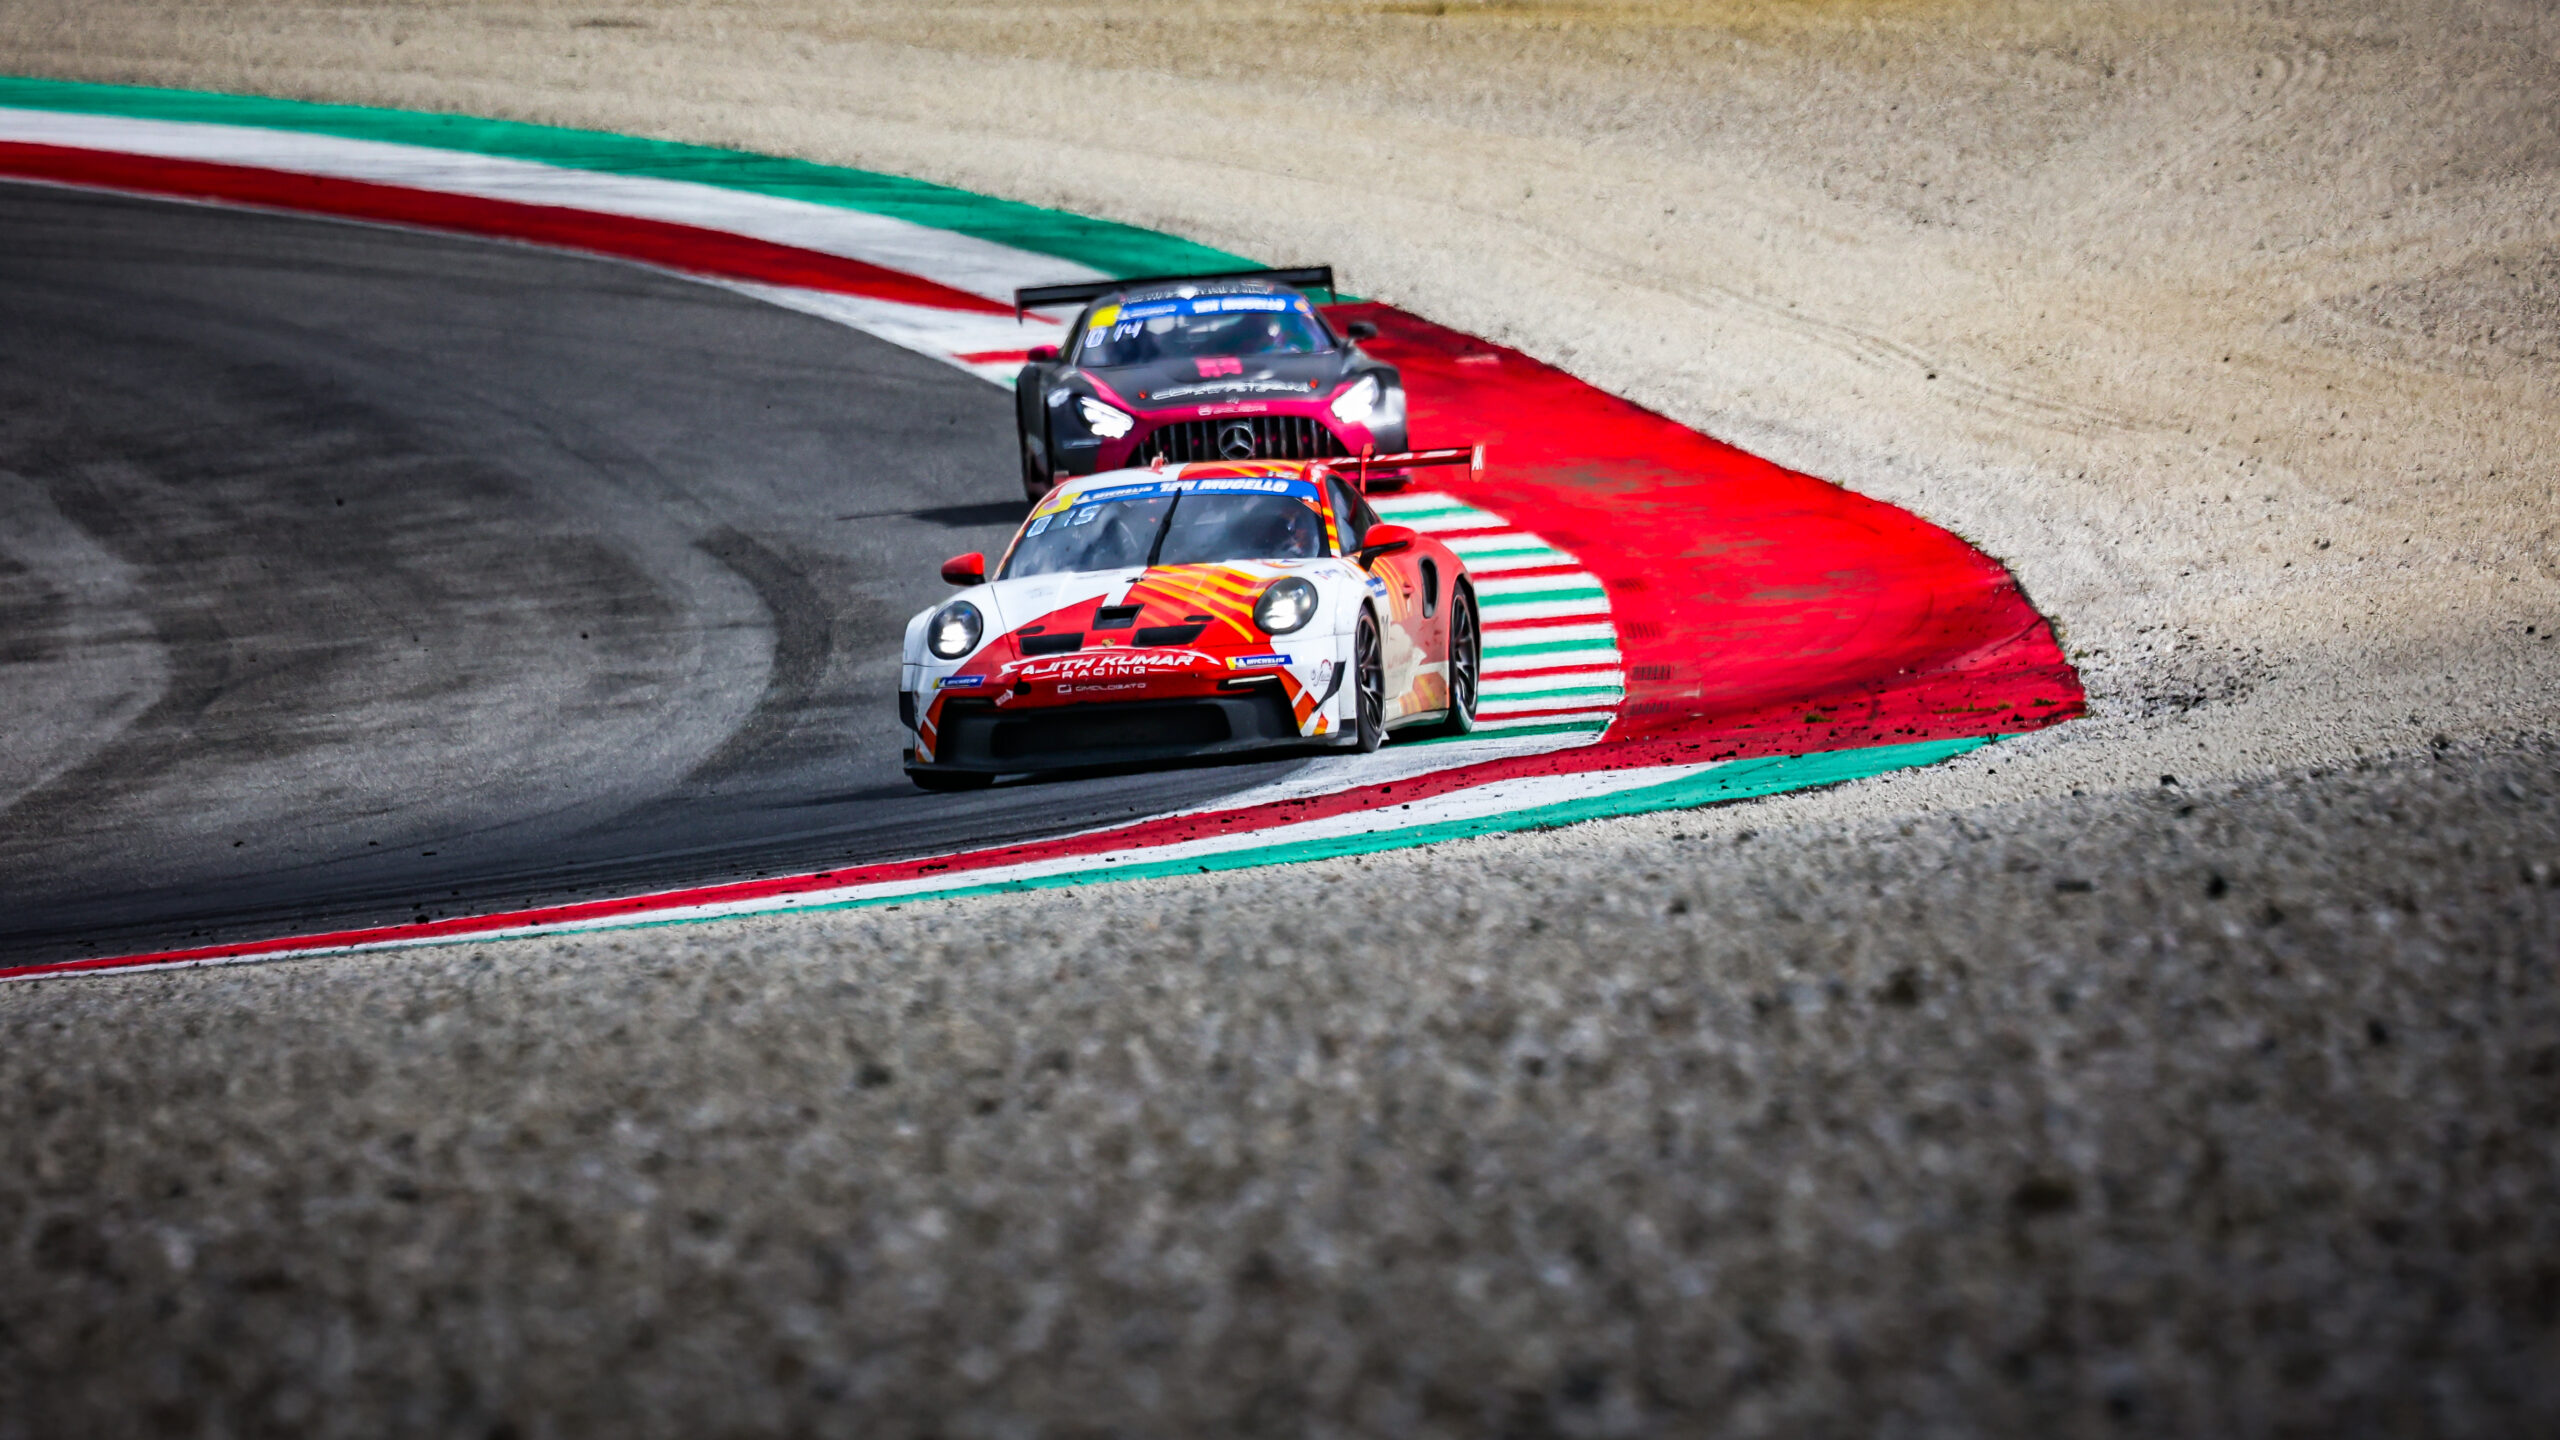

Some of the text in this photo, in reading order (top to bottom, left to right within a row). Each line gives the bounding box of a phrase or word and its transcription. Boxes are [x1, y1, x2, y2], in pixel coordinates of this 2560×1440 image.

[1199, 478, 1289, 493] MUGELLO
[1021, 655, 1197, 675] AJITH KUMAR
[1246, 657, 1285, 665] MICHELIN
[1061, 666, 1147, 679] RACING
